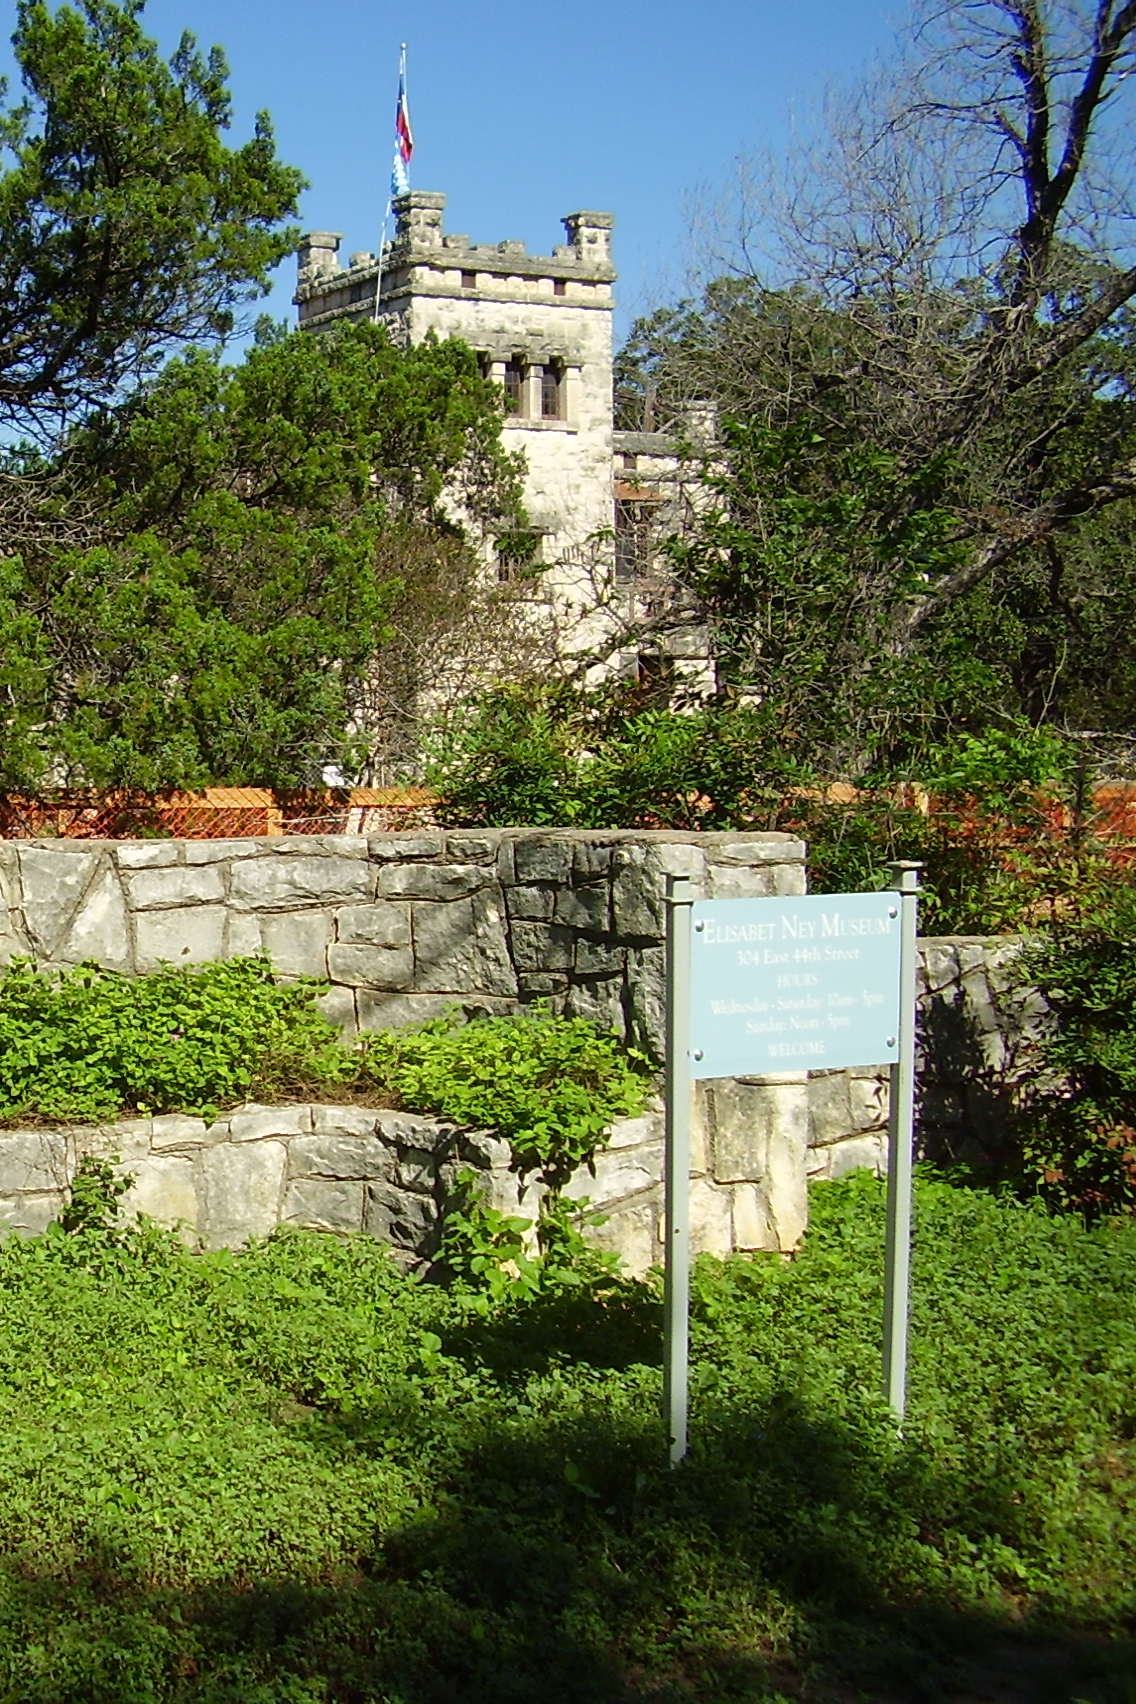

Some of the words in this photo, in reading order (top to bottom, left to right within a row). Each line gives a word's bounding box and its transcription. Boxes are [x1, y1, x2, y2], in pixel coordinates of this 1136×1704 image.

[737, 950, 759, 966] 304
[764, 950, 789, 965] East
[824, 945, 860, 960] Street
[768, 1040, 825, 1057] WELCOME
